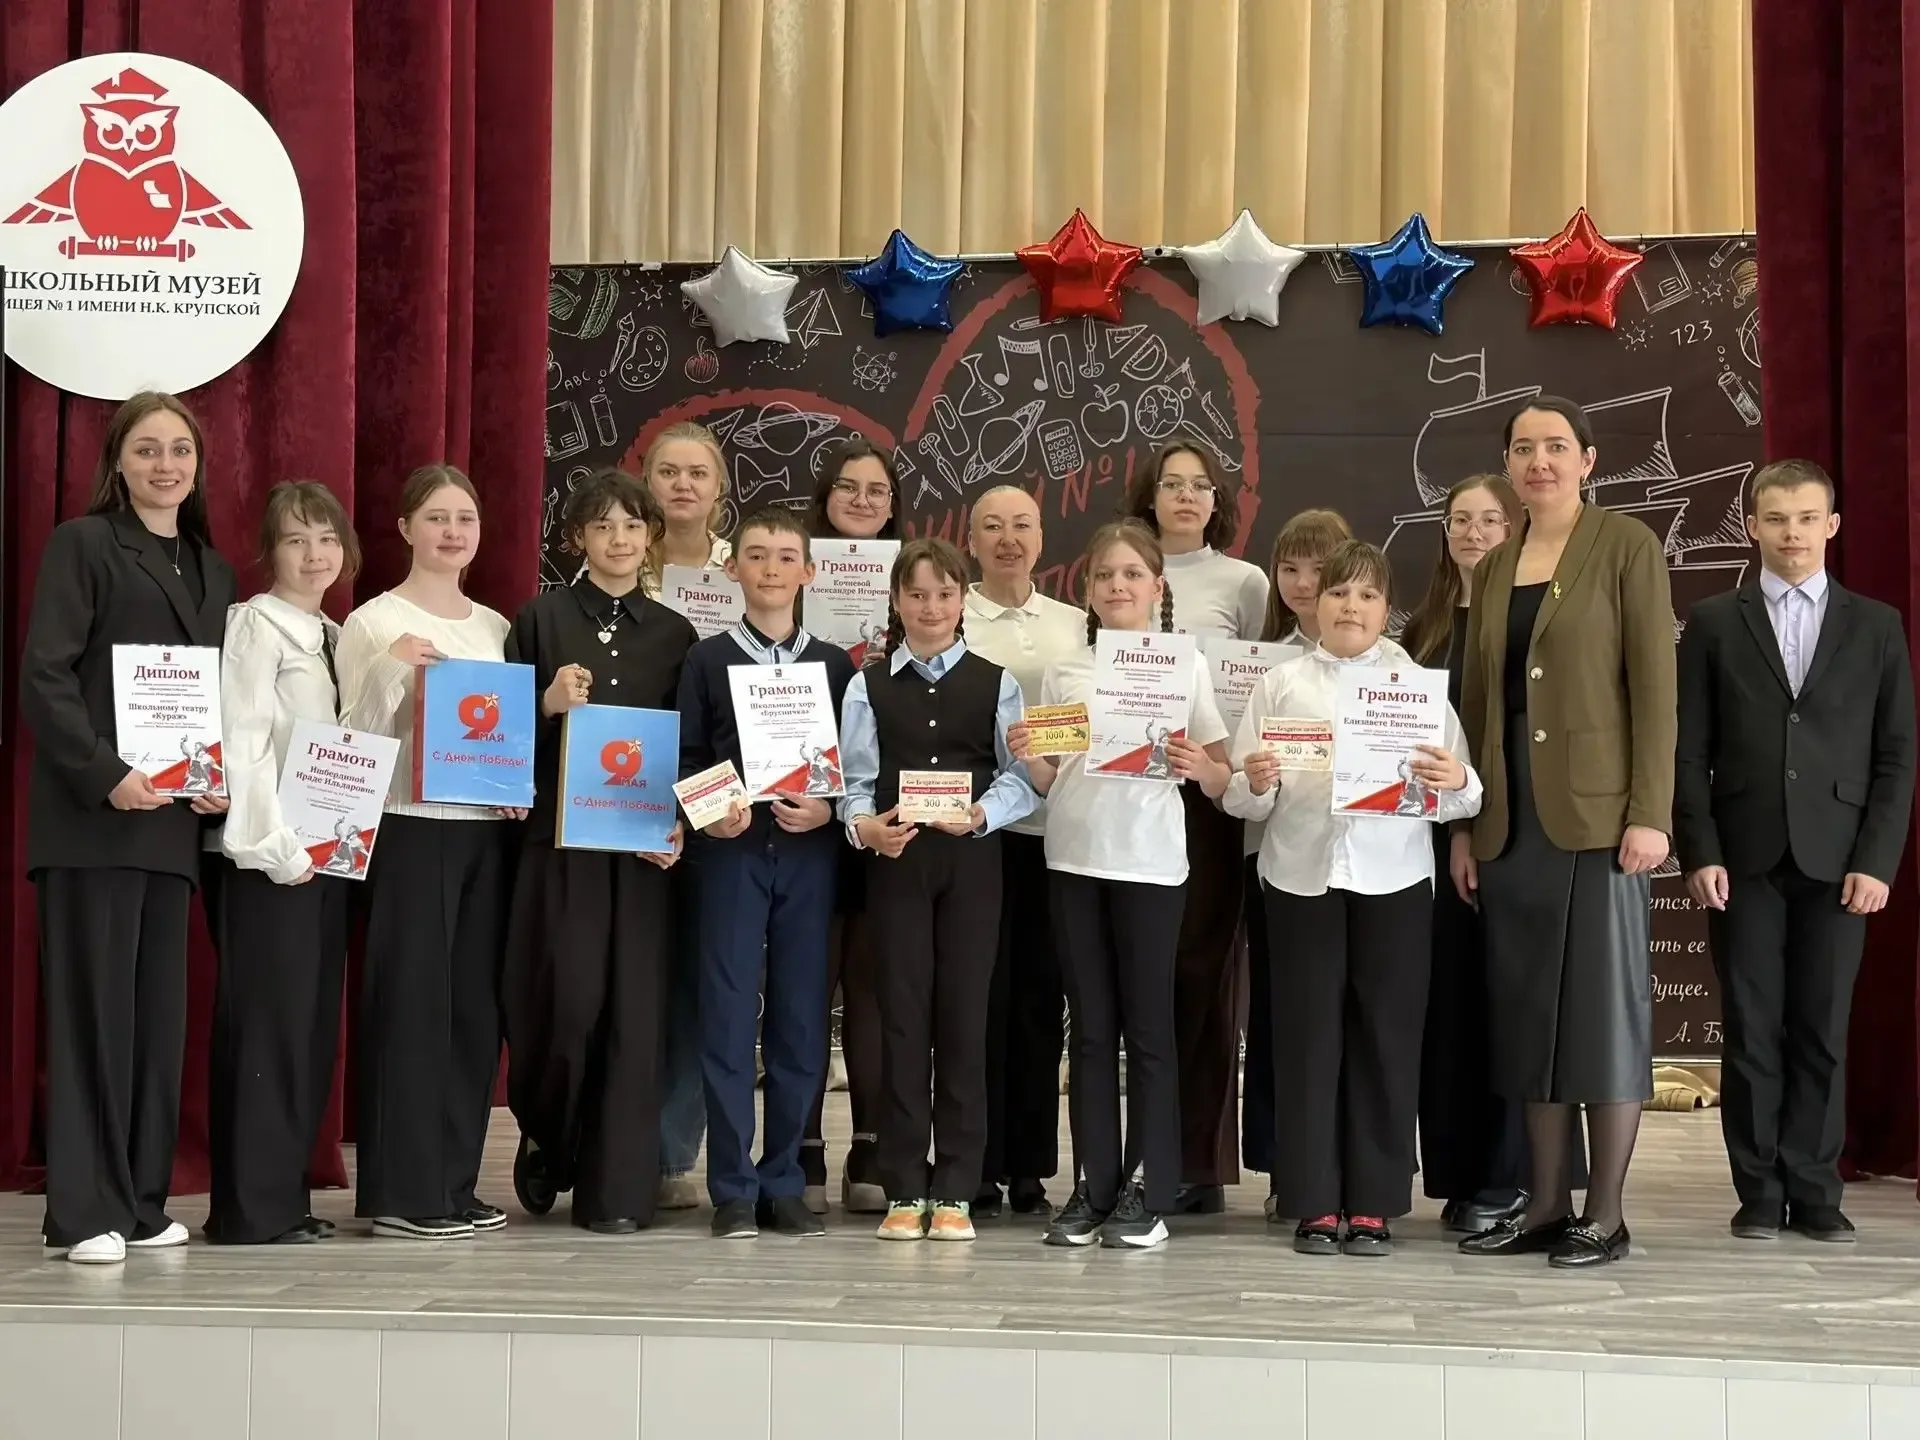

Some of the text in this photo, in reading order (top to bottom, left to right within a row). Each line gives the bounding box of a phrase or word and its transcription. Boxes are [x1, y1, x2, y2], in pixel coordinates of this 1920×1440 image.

[168, 272, 261, 298] МУЗЕЙ
[78, 300, 135, 313] ИМЕНИ
[140, 302, 169, 314] Н.К.
[174, 301, 260, 317] КРУПСКОЙ
[1669, 319, 1713, 346] 123
[564, 370, 591, 391] ABC
[821, 560, 884, 574] Грамота
[676, 586, 733, 605] Грамота
[809, 586, 891, 597] Александре Игоревн
[1112, 648, 1177, 666] Диплом
[133, 665, 201, 681] Диплом
[1220, 659, 1272, 676] Грамо
[748, 684, 813, 699] Грамота
[1096, 688, 1187, 702] Вокальному ансамблю
[1357, 686, 1429, 704] Грамота
[128, 703, 209, 714] Школьному театру
[1365, 709, 1418, 721] Шульженко
[1343, 717, 1439, 730] Елизавете Евгеньевне
[479, 731, 505, 743] МАЯ
[307, 742, 377, 769] Грамота
[620, 776, 647, 788] МАЯ
[1687, 940, 1706, 953] ее
[1665, 1020, 1691, 1043] А.
